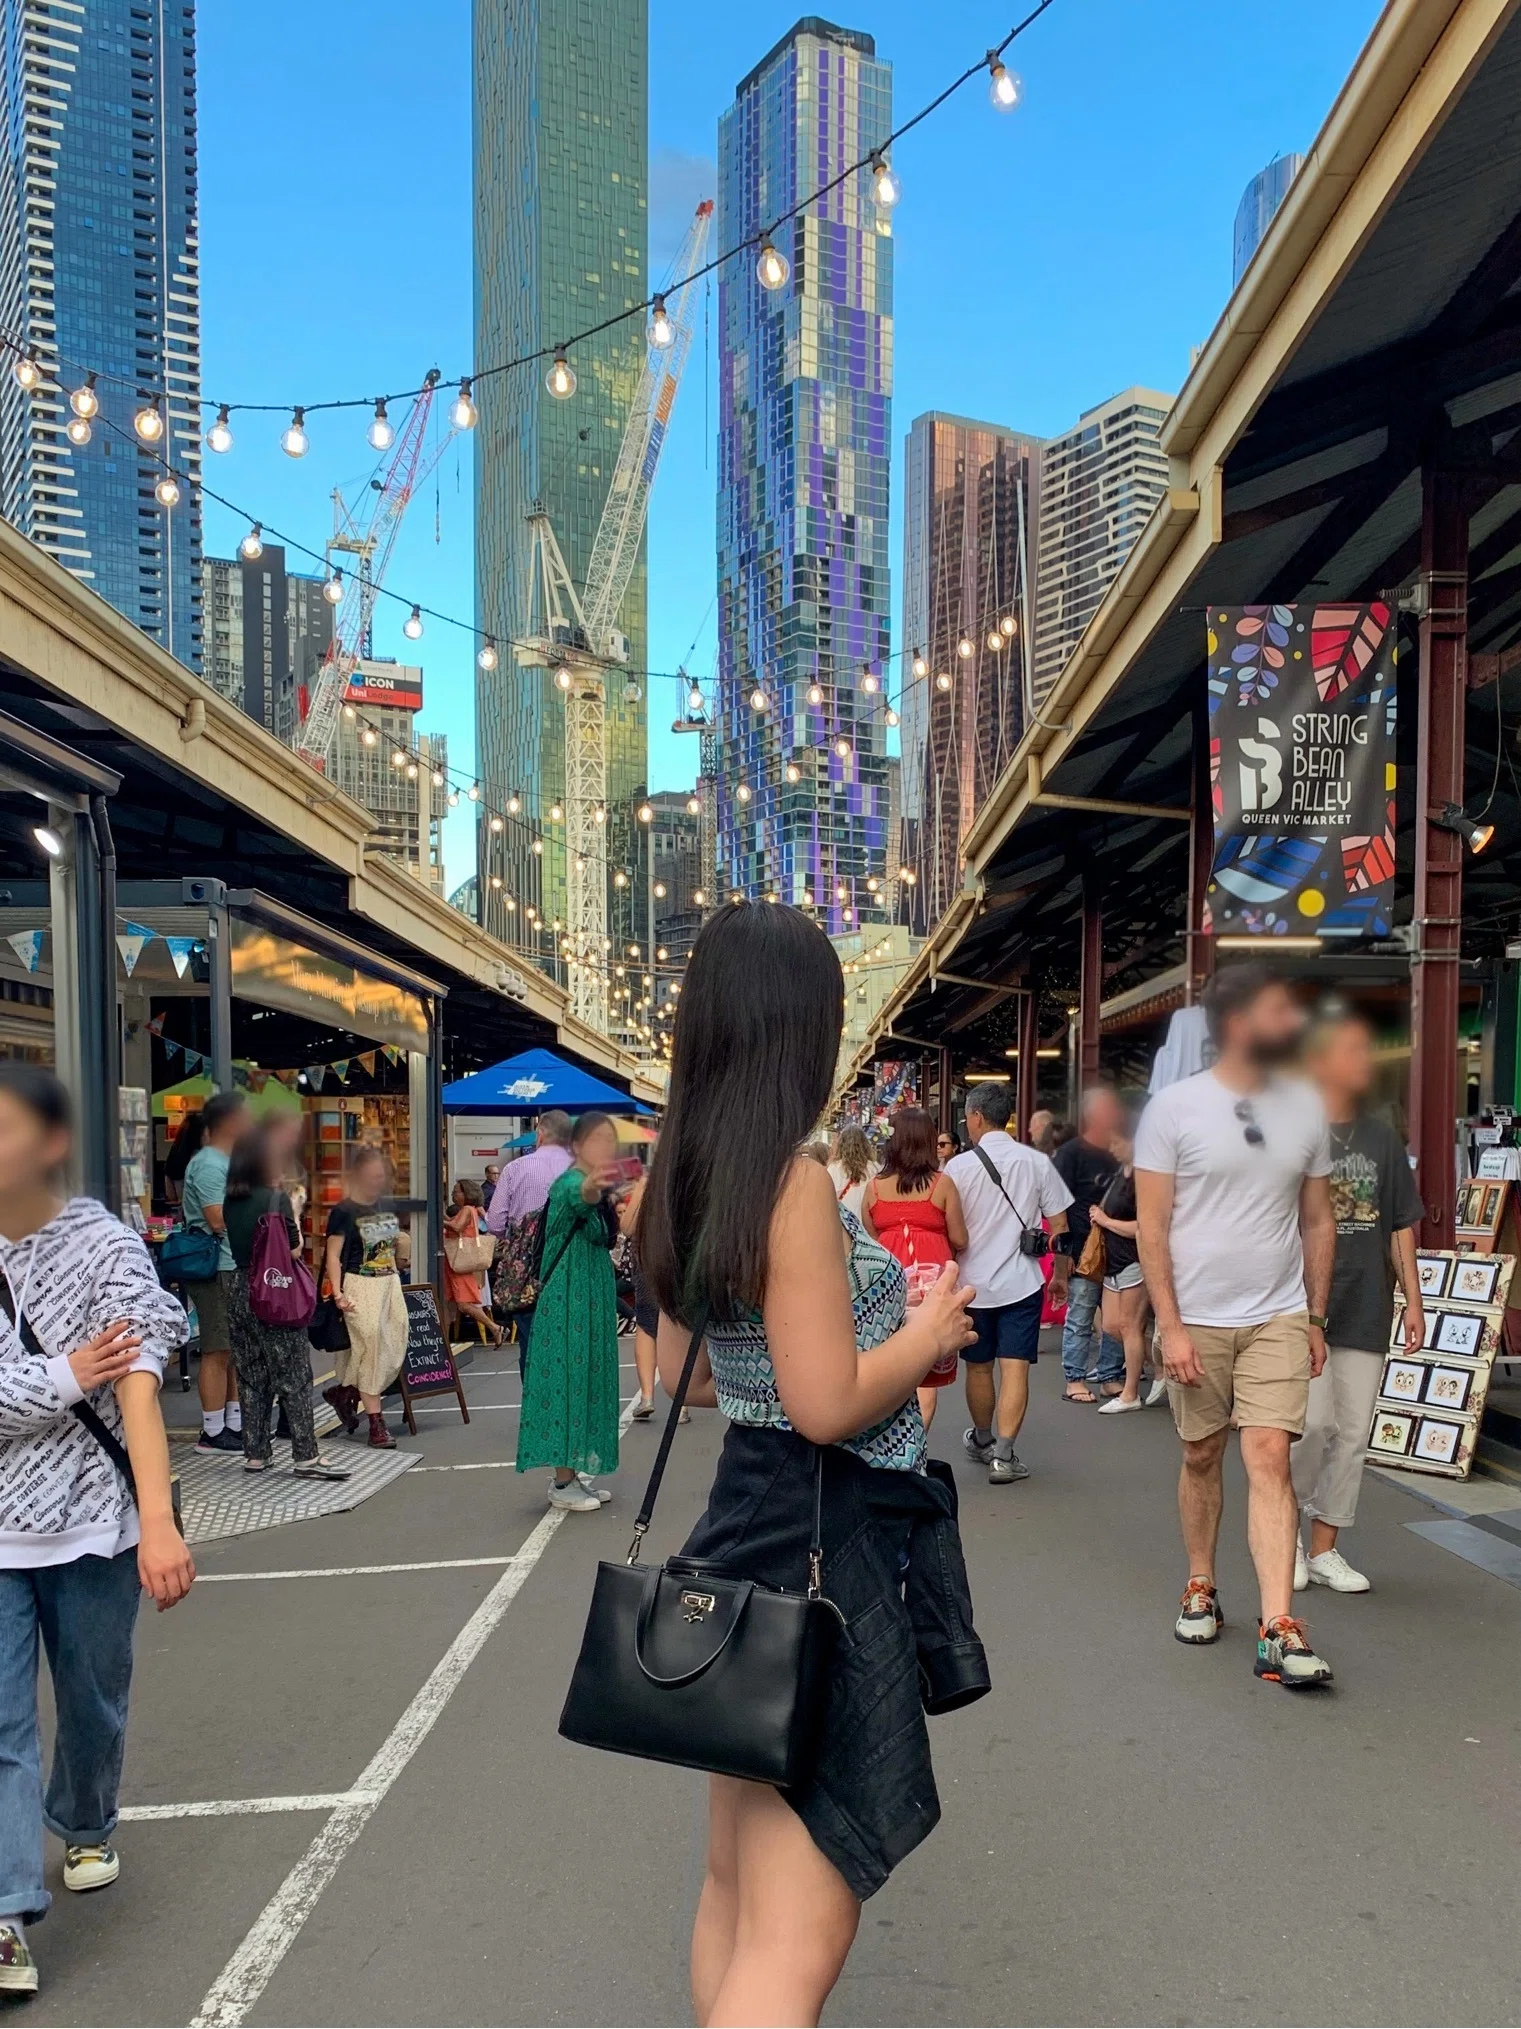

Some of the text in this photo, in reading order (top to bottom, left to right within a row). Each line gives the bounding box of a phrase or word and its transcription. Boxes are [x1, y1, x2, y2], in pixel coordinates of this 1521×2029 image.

[365, 676, 394, 690] ICON
[1292, 713, 1368, 744] STRING
[1293, 747, 1344, 778] BEAN
[1292, 781, 1352, 811] ALLEY
[1242, 813, 1352, 826] QUEEN VIC MARKET
[17, 1473, 48, 1503] CONVERSE
[43, 1469, 72, 1499] CONVERSE
